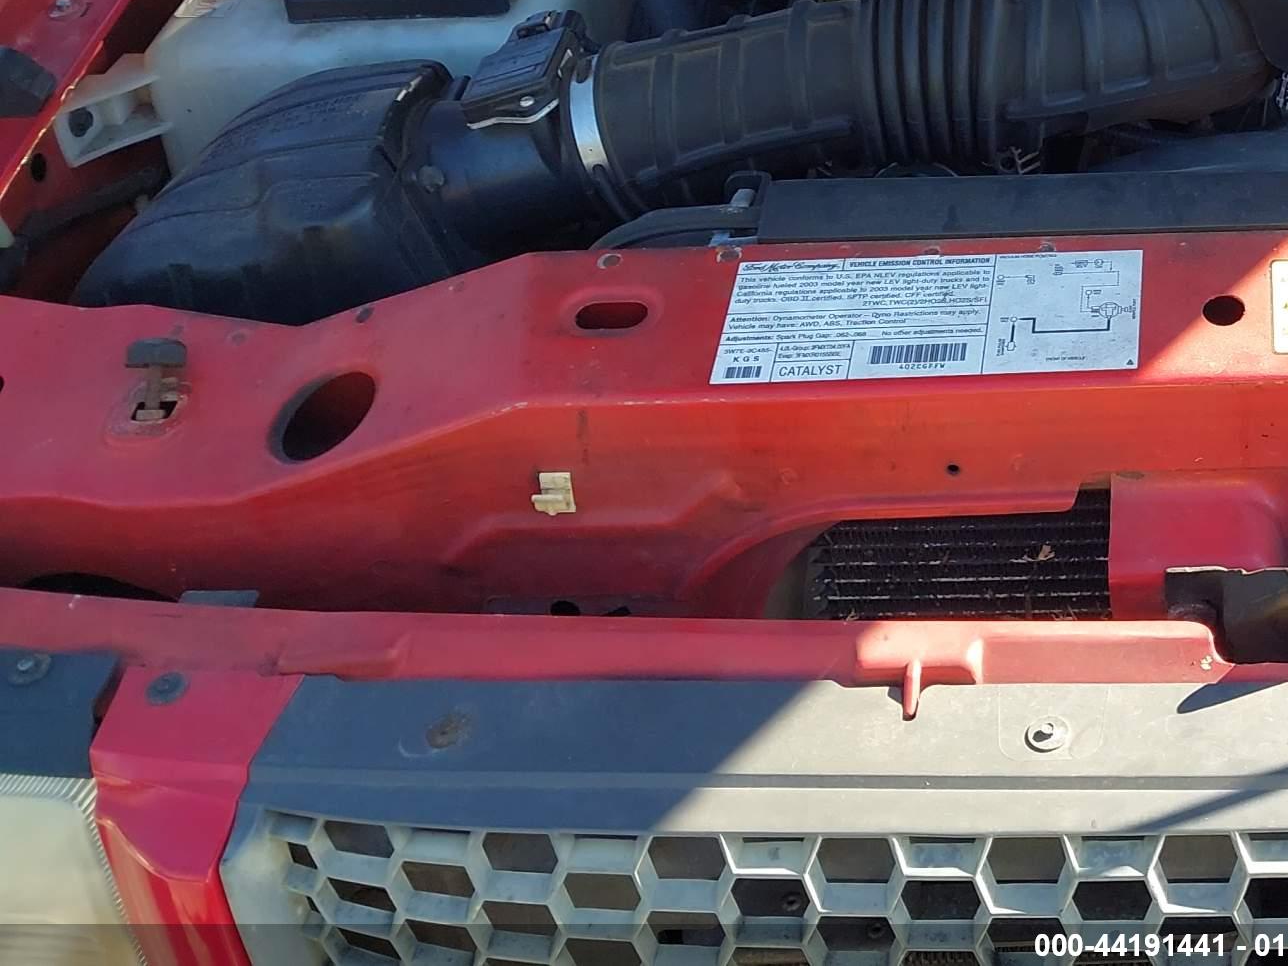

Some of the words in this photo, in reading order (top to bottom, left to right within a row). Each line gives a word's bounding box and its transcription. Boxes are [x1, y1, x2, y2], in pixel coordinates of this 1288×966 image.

[879, 259, 911, 267] EMISSION
[945, 257, 990, 265] INFORMATION
[898, 271, 939, 279] regulations
[942, 269, 980, 277] applicable
[902, 277, 938, 285] light-duty
[775, 288, 817, 296] regulations
[819, 287, 858, 295] applicable
[735, 297, 752, 305] duty
[772, 313, 826, 321] Dynamometer
[828, 312, 862, 320] Operator
[776, 333, 796, 341] Spark
[778, 364, 843, 377] CATALYST
